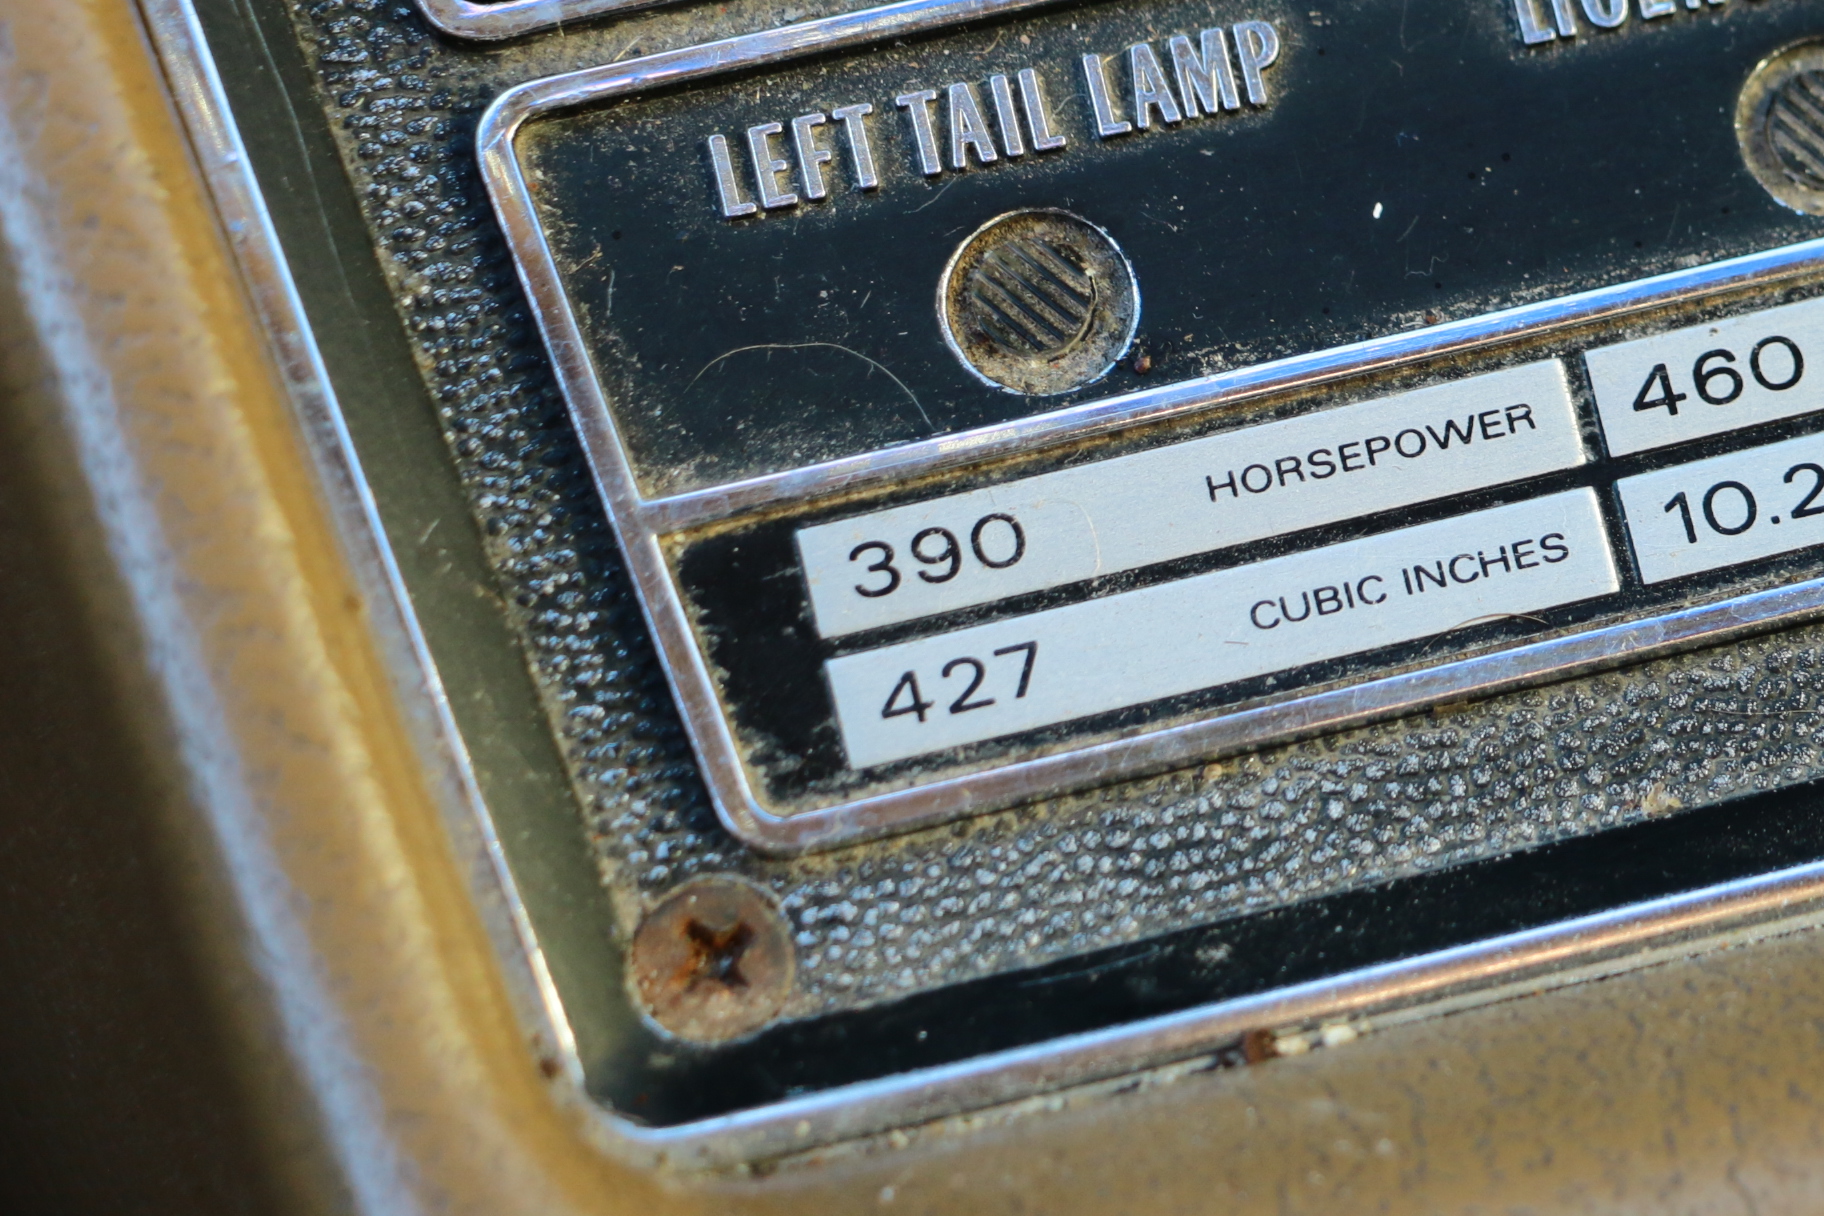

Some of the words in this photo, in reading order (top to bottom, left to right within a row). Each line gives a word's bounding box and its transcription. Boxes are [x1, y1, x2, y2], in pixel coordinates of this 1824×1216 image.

[707, 103, 878, 218] LEFT
[895, 68, 1067, 176] TAIL
[1081, 20, 1281, 138] LAMP
[1631, 335, 1804, 417] 460
[848, 513, 1027, 599] 390
[1206, 403, 1537, 503] HORSEPOWER
[880, 641, 1039, 724] 427
[1249, 583, 1390, 630] CUBIC
[1402, 532, 1571, 597] INCHES
